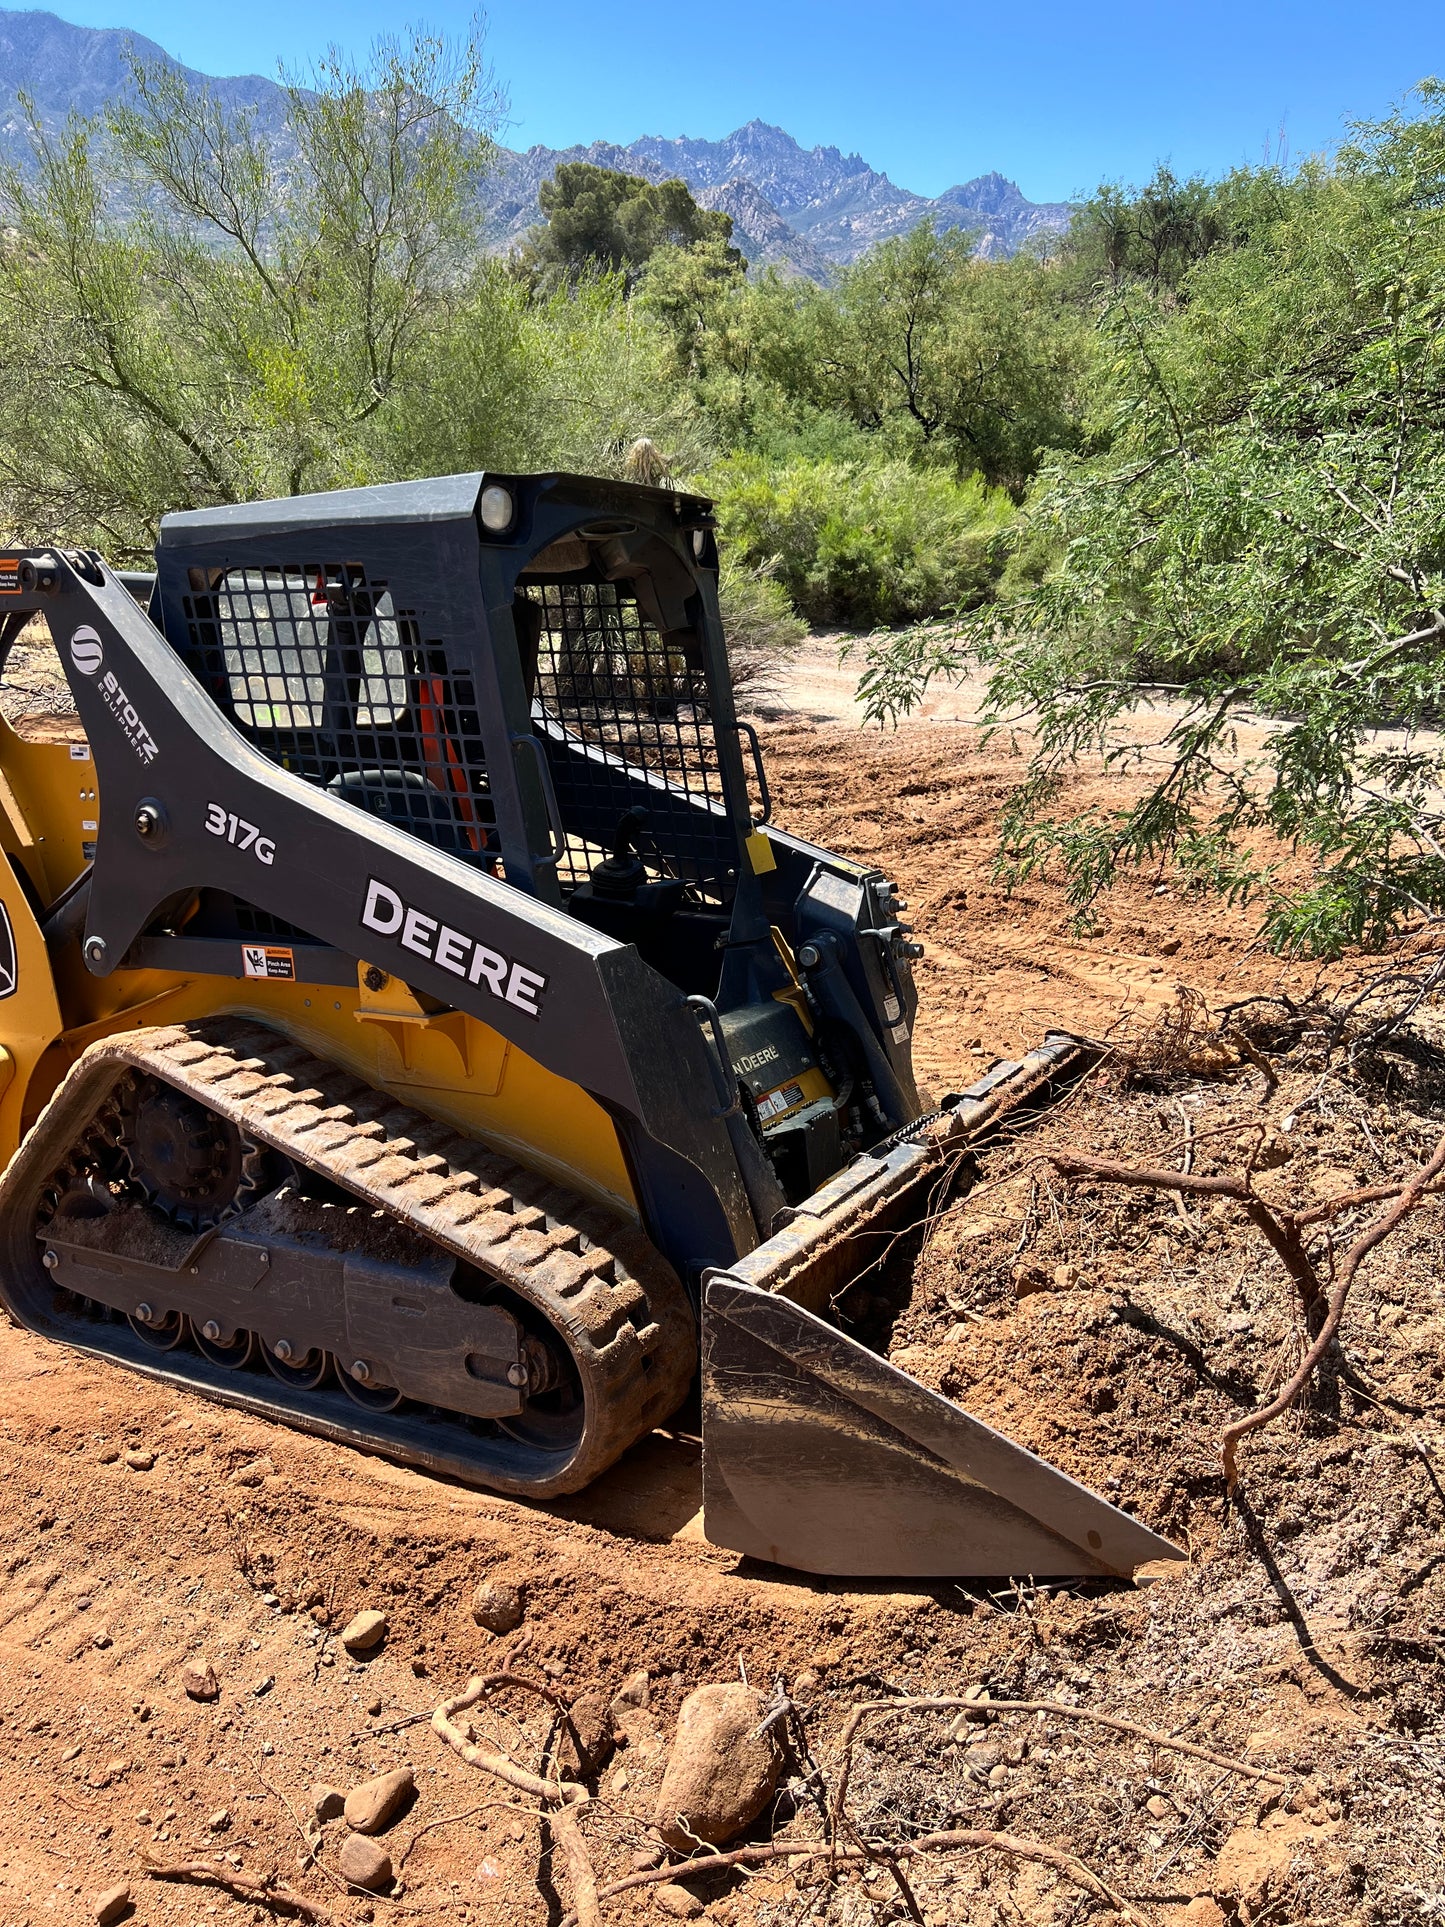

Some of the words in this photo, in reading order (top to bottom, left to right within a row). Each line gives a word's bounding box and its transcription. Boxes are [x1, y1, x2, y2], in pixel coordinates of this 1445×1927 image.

[97, 682, 150, 765] EQUIPMENT
[103, 671, 159, 760] STOTZ
[204, 803, 276, 865] 317G
[362, 878, 546, 1016] DEERE
[740, 1045, 779, 1072] DEERE
